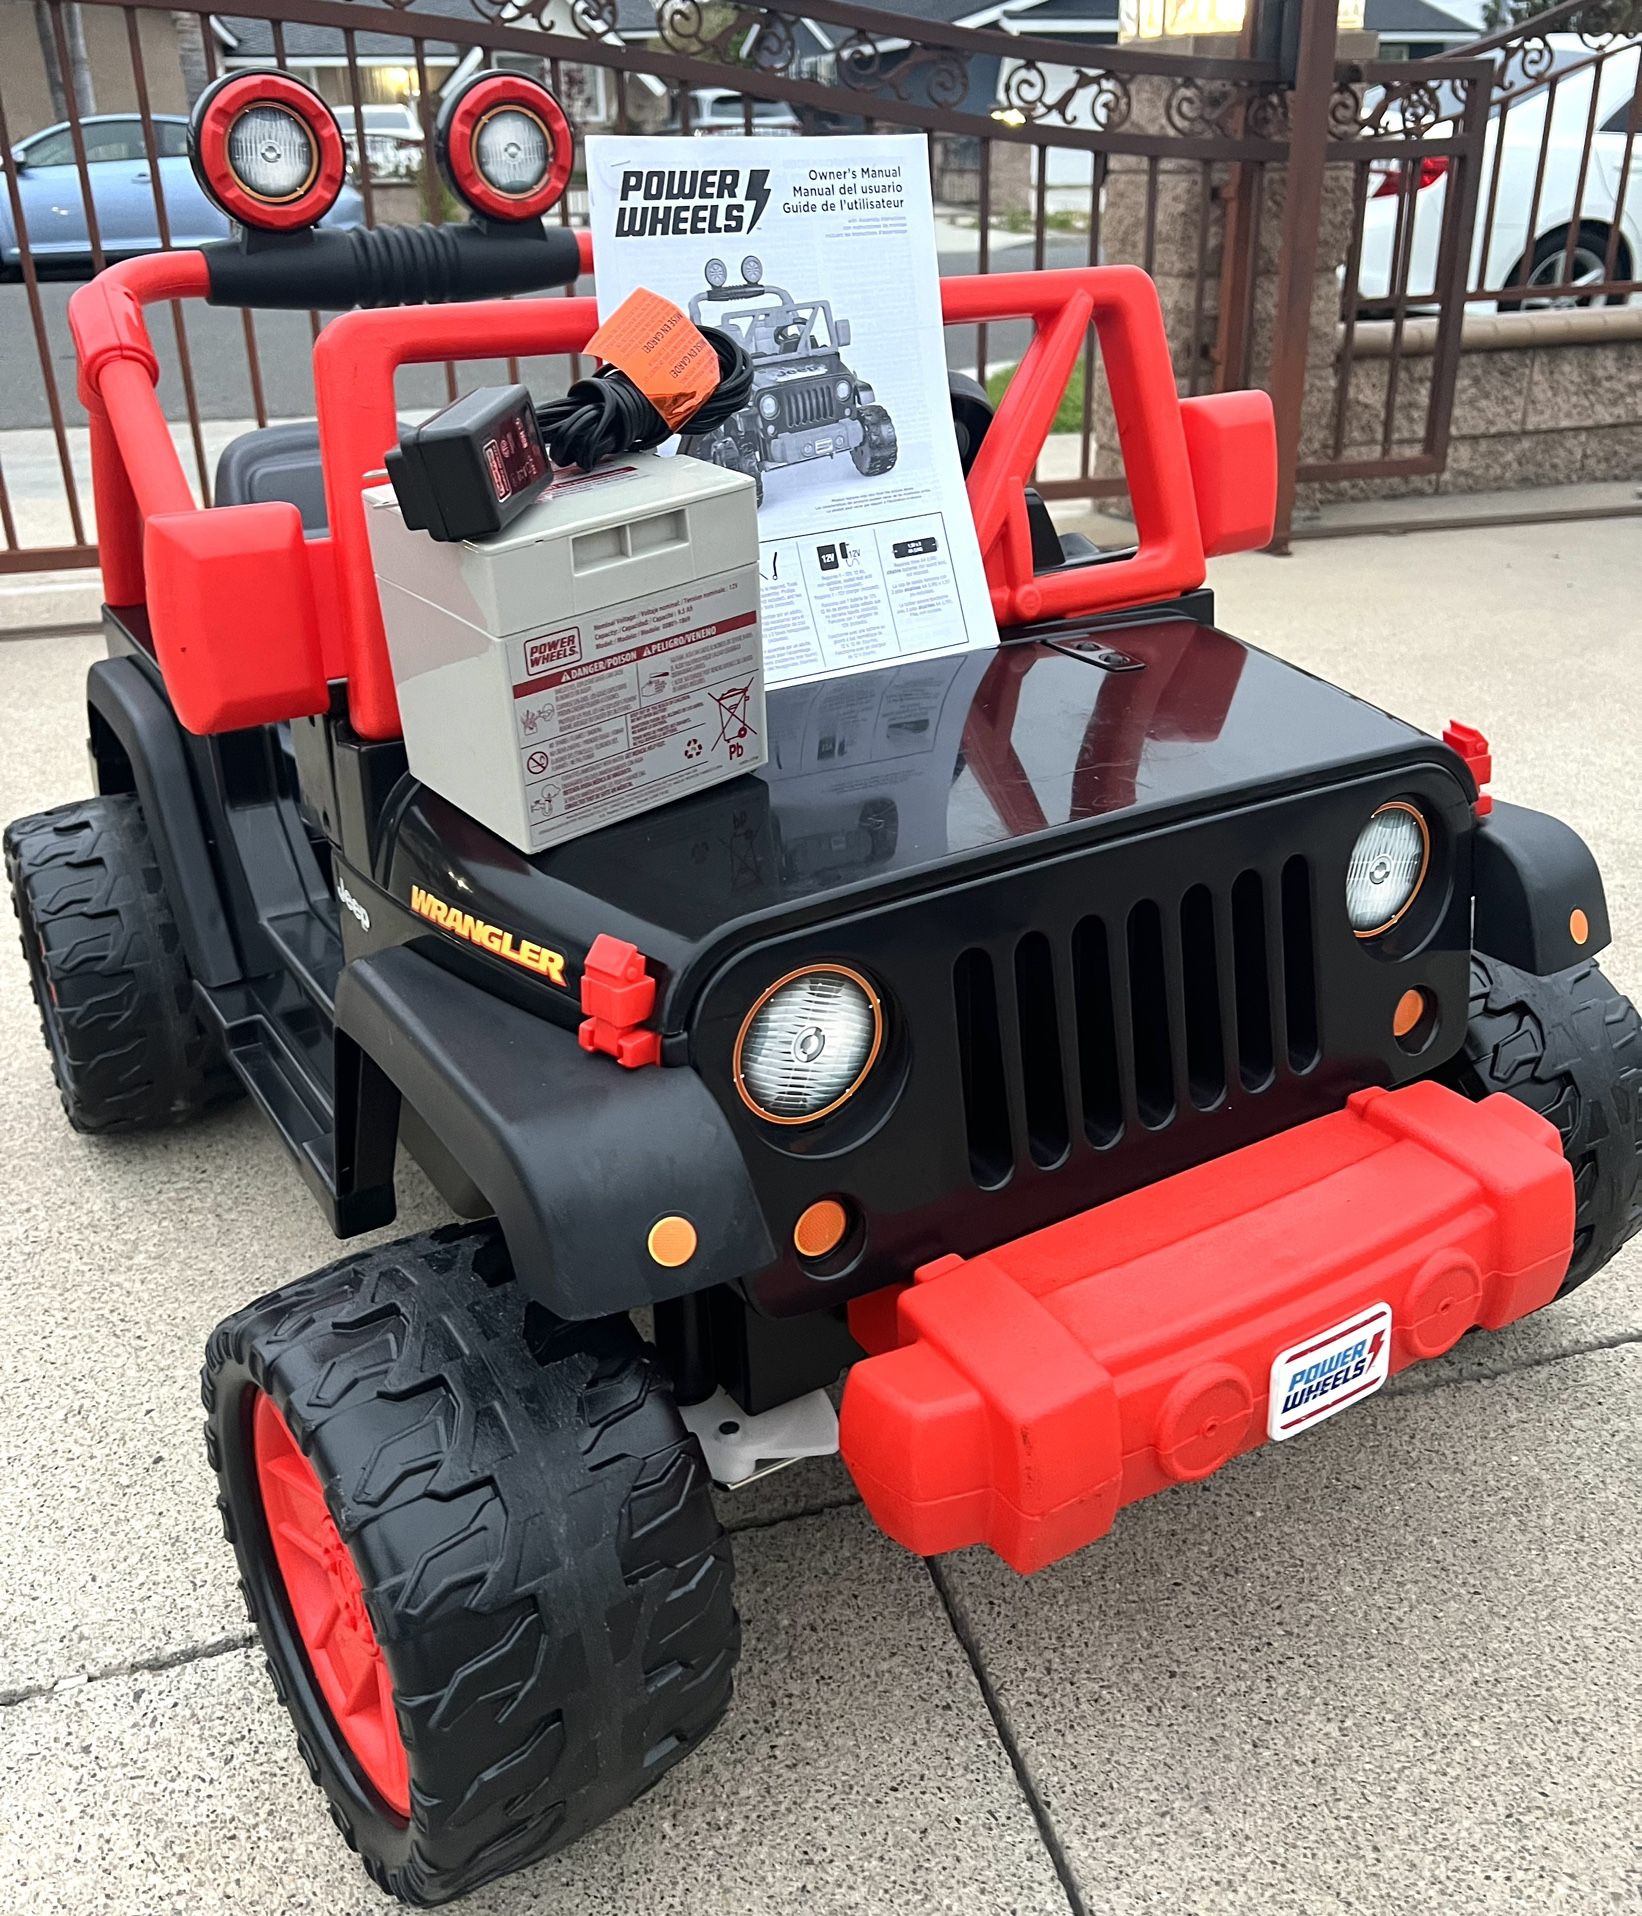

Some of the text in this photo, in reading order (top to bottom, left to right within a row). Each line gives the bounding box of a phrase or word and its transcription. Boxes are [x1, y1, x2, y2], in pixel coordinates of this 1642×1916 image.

[620, 169, 741, 201] POWER
[808, 167, 902, 181] Owner's Manual
[793, 183, 903, 197] Manual del usuario
[782, 198, 904, 214] Guide de l'utilisateur
[615, 204, 744, 237] WHEELS
[660, 323, 672, 335] EN
[686, 348, 697, 359] EN
[821, 553, 835, 563] 12V
[848, 549, 861, 558] 12V
[529, 634, 576, 659] POWER
[530, 645, 577, 669] WHEELS
[571, 650, 637, 680] DANGER/POISON
[651, 626, 717, 654] PELIGRO/VENENO
[729, 742, 744, 761] Pb
[337, 877, 370, 932] Jeep
[411, 884, 568, 987] WRANGLER
[1288, 1339, 1367, 1392] POWER
[1281, 1357, 1367, 1414] WHEELS
